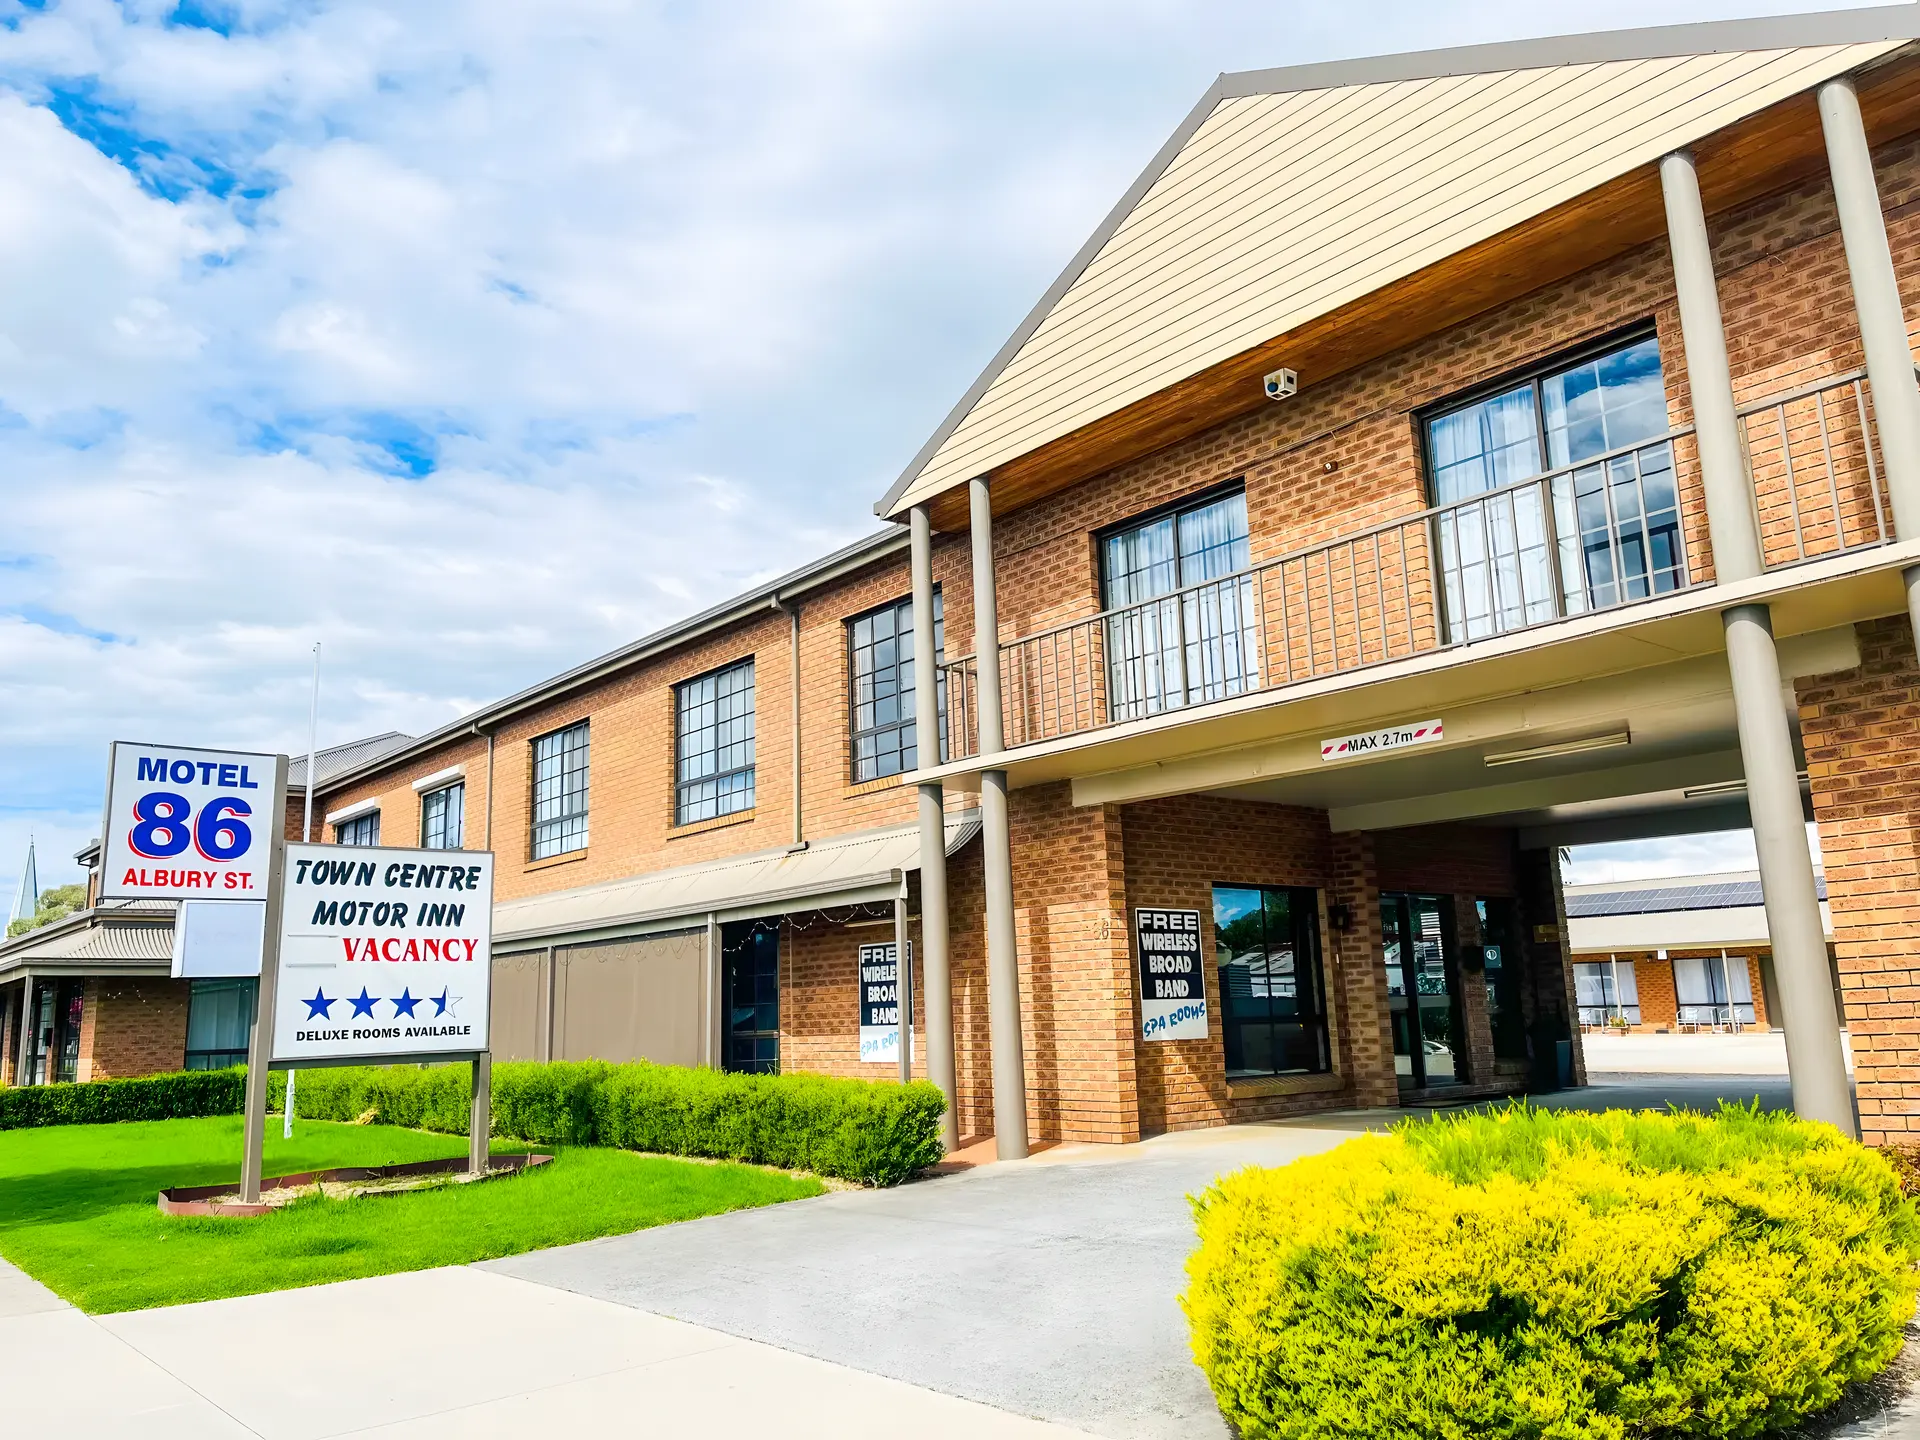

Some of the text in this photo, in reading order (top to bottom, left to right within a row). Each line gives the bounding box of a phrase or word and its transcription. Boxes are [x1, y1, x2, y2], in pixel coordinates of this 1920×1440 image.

[1347, 731, 1413, 752] MAX 2.7m
[137, 757, 258, 789] MOTEL
[127, 791, 253, 863] 86
[122, 868, 254, 890] ALBURY ST.
[296, 859, 482, 892] TOWN CENTRE
[311, 900, 466, 928] MOTOR INN
[1139, 912, 1198, 931] FREE
[342, 937, 479, 963] VACANCY
[1140, 932, 1198, 952] WIRELESS
[861, 945, 909, 964] FRE
[1148, 955, 1193, 974] BROAD
[862, 964, 897, 983] WIRELE
[867, 985, 897, 1003] BROA
[1155, 979, 1190, 998] BAND
[1143, 1002, 1205, 1037] SPA ROOMS
[296, 1025, 471, 1042] DELUXE ROOMS AVAILABLE
[860, 1039, 879, 1057] SPA
